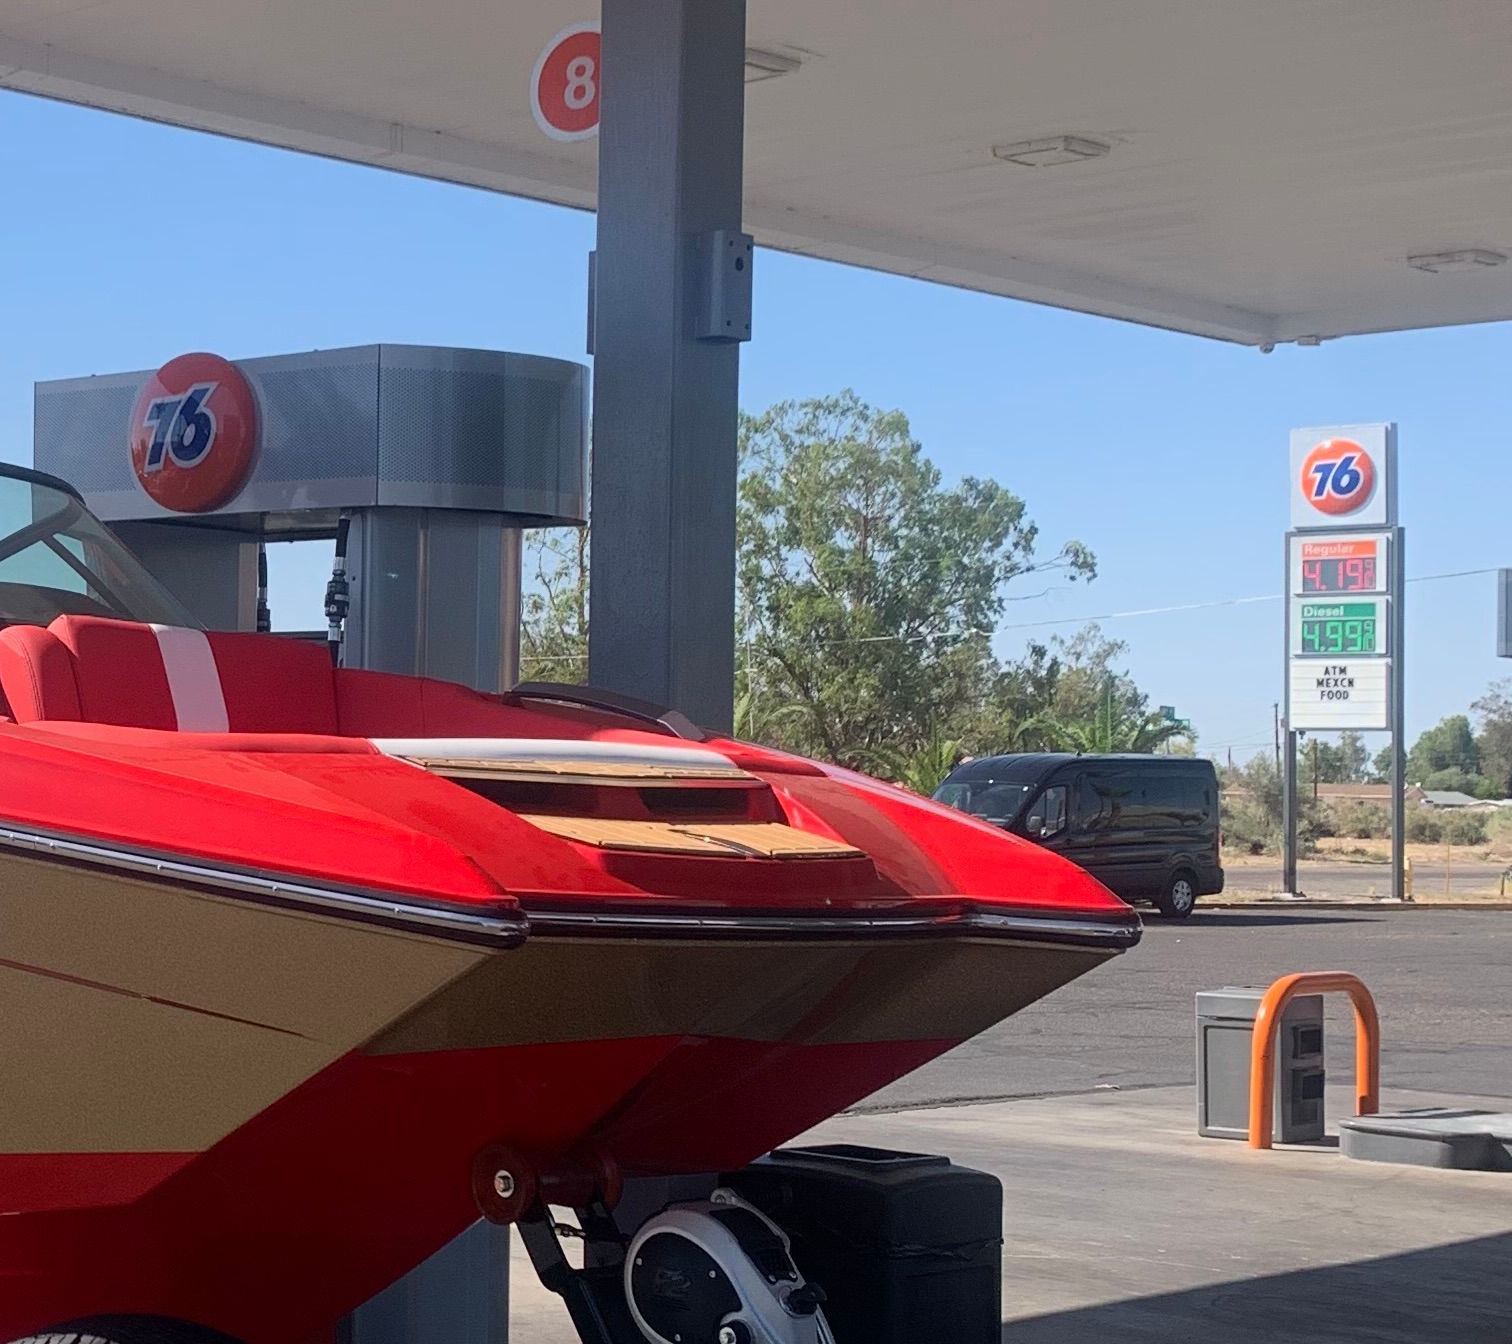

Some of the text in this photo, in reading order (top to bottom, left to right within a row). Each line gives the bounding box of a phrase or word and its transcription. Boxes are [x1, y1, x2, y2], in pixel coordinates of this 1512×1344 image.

[564, 56, 595, 110] 8
[144, 383, 218, 472] 76
[1311, 454, 1362, 499] 76
[1304, 544, 1355, 557] Regular
[1304, 559, 1363, 591] 4.19
[1303, 605, 1344, 617] Diesel
[1303, 621, 1363, 652] 4.99
[1324, 666, 1347, 676] ATM
[1320, 690, 1349, 700] FOOD
